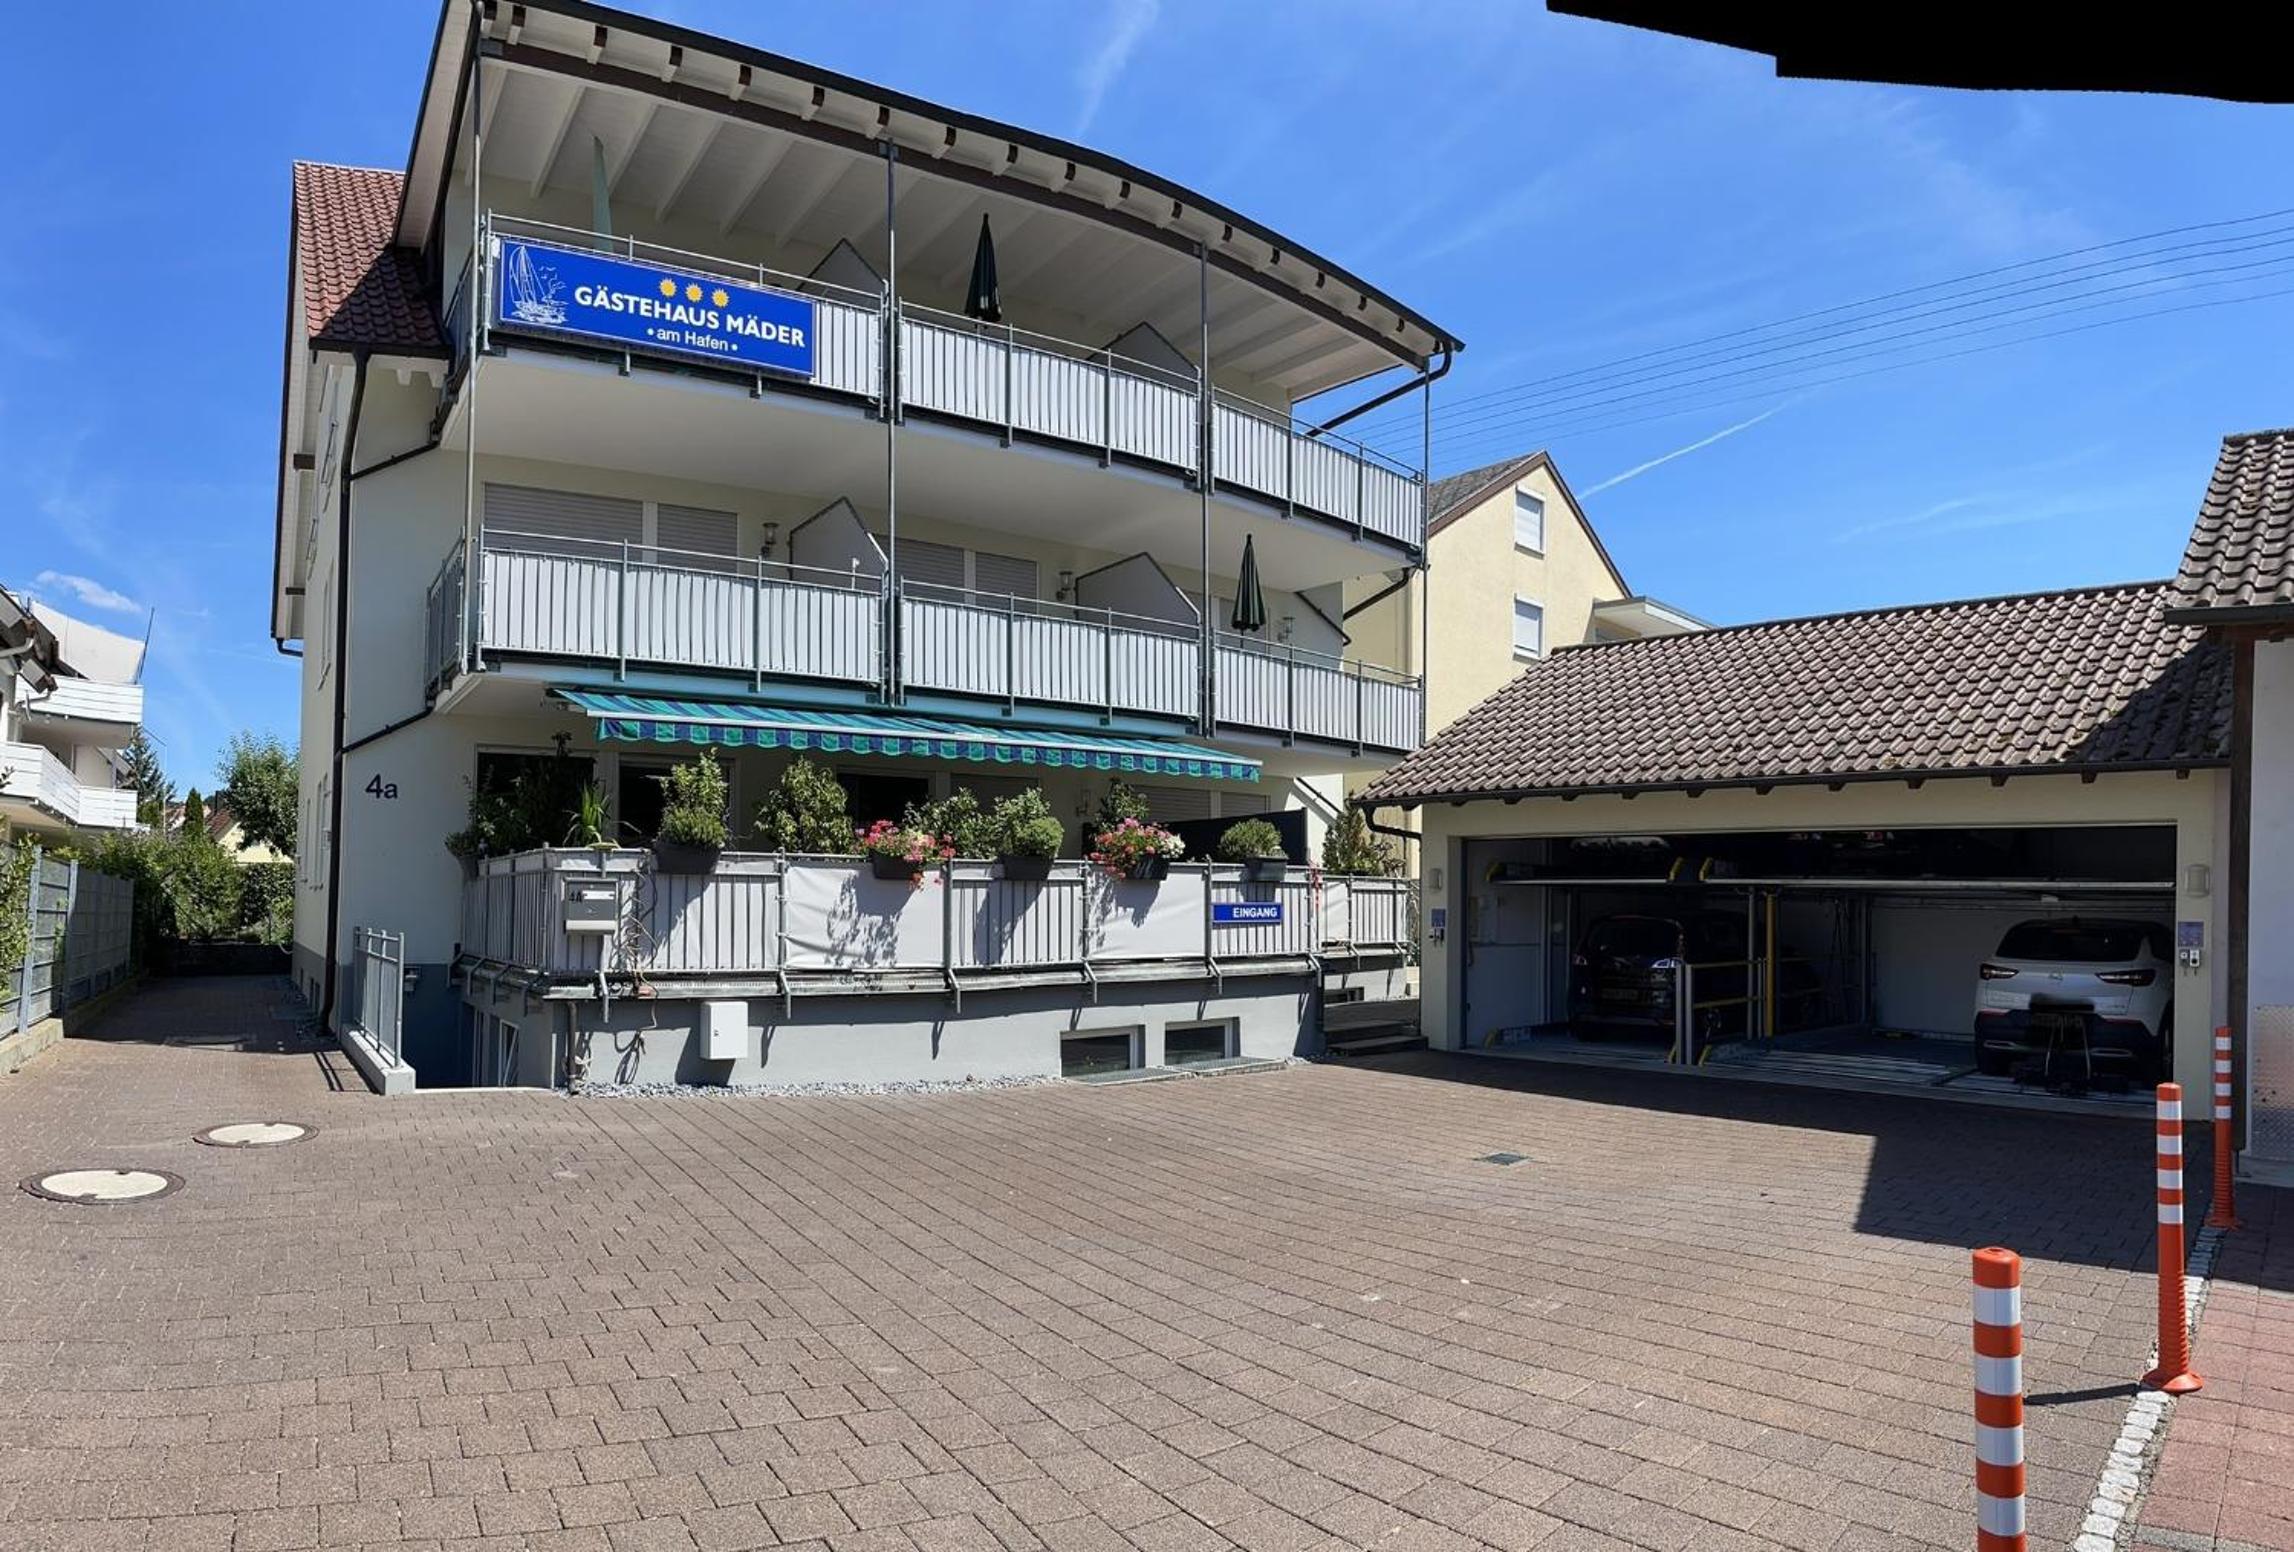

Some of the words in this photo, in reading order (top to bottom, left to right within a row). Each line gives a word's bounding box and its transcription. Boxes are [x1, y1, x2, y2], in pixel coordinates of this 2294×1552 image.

[574, 285, 720, 330] GÄSTEHAUS
[726, 313, 806, 348] MÄDER
[656, 328, 680, 344] am
[684, 330, 729, 352] Hafen
[365, 773, 398, 799] 4a
[1232, 907, 1278, 919] EINGANG
